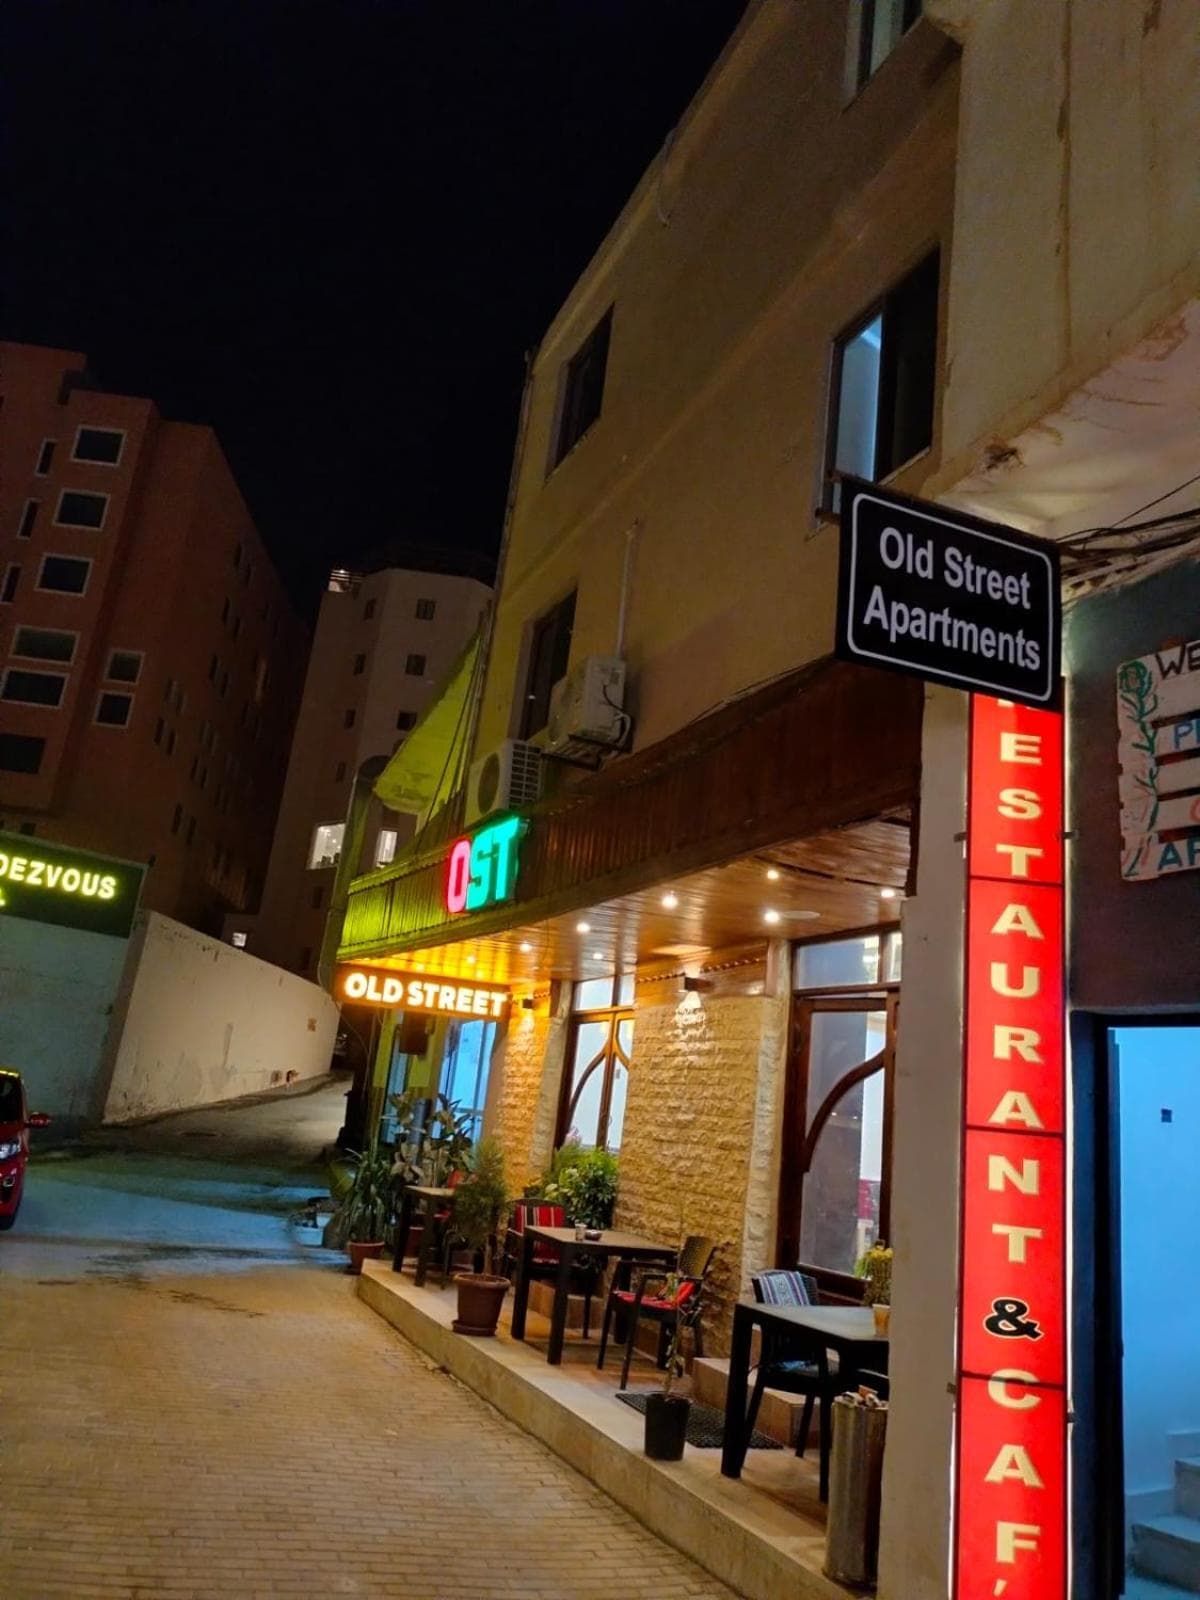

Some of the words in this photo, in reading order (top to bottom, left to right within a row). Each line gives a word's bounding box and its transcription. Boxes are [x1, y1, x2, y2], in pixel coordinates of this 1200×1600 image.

[879, 526, 935, 580] Old
[943, 546, 1032, 610] Street
[863, 585, 1041, 672] Apartments
[447, 817, 519, 913] OST
[344, 973, 404, 1003] OLD
[407, 981, 507, 1017] STREET
[987, 697, 1044, 1263] ESTAURANT
[984, 1297, 1043, 1341] &
[984, 1368, 1044, 1597] CAF
